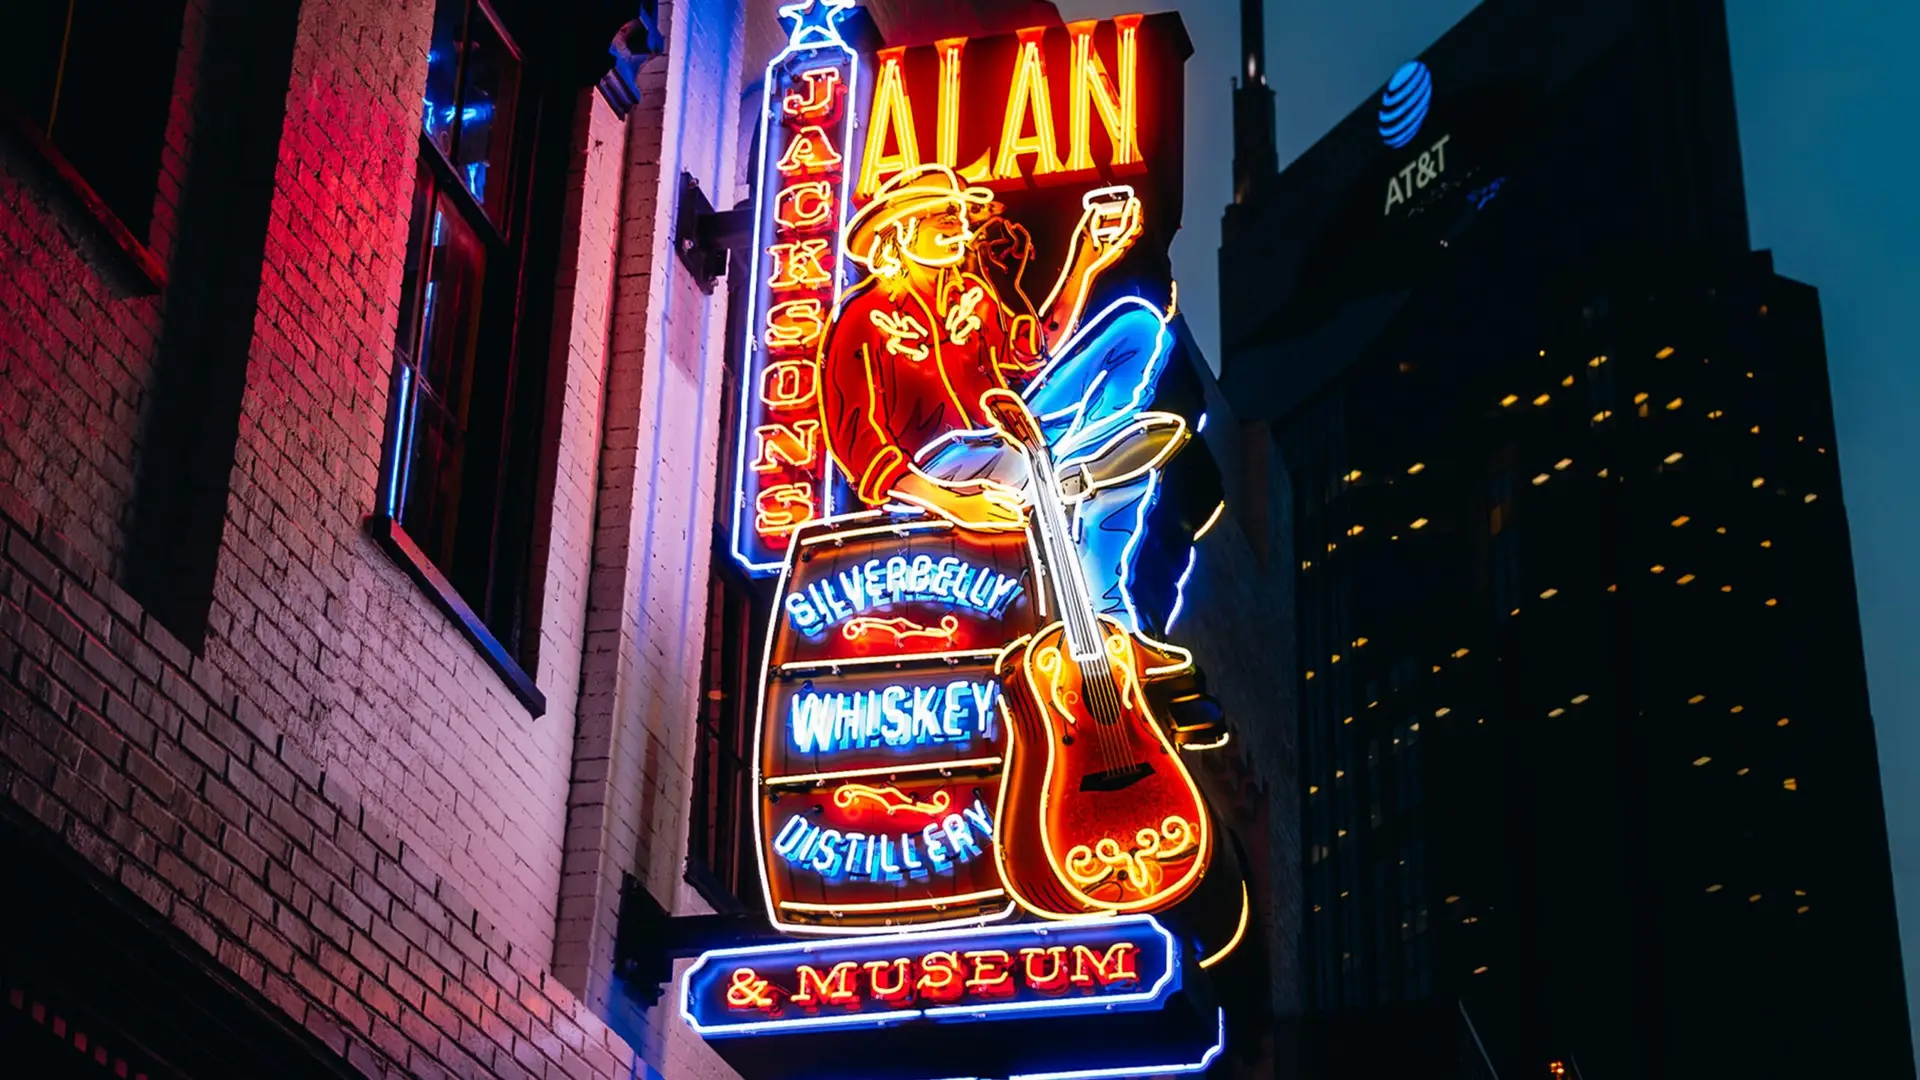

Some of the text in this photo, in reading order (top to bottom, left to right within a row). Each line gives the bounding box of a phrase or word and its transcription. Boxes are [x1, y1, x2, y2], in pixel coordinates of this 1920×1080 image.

[854, 13, 1145, 199] ALAN
[1384, 134, 1450, 215] AT&T
[785, 554, 1021, 634] SILVERBELLY
[791, 679, 999, 753] WHISKEY
[773, 799, 995, 881] DISTILLERY
[726, 942, 1140, 1014] & MUSEUM
